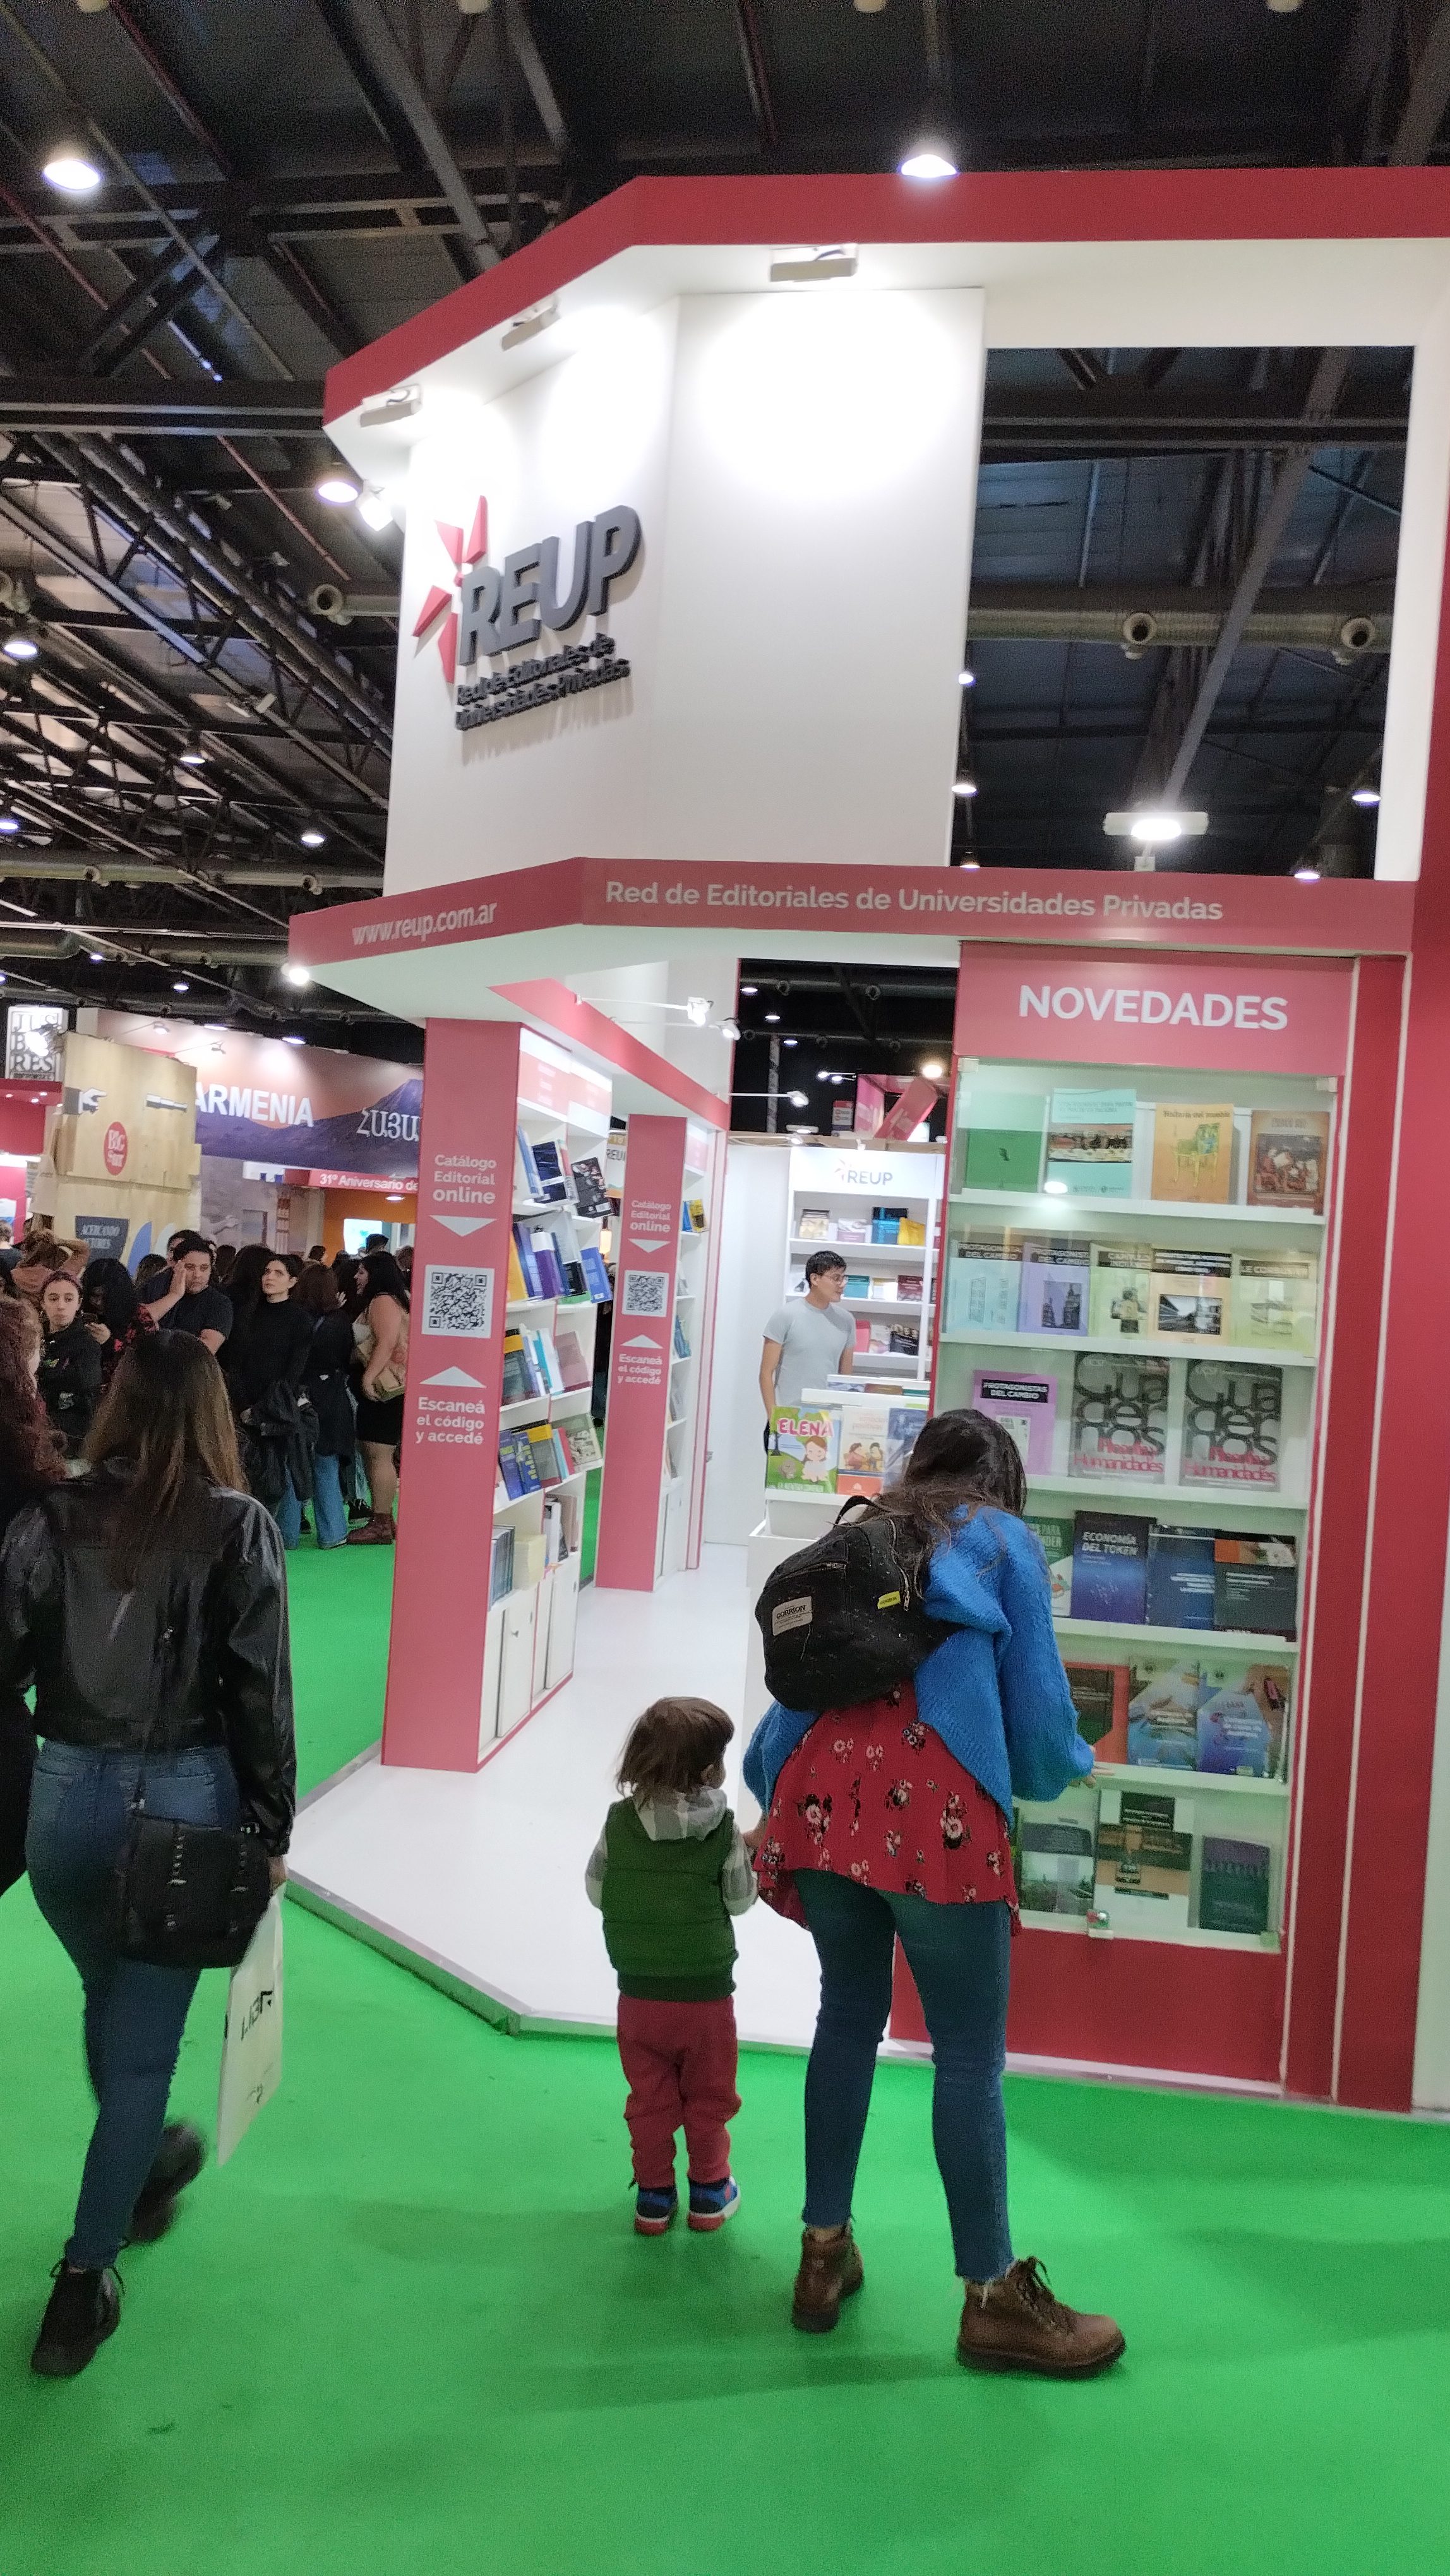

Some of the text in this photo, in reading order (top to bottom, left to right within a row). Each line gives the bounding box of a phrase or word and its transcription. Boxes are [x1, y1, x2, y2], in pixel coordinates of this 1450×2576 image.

[459, 505, 642, 665] REUP
[606, 881, 1223, 921] Red de Editoriales de Universidades Privadas
[351, 902, 498, 946] www.reup.com.ar
[1018, 984, 1288, 1031] NOVEDADES
[196, 1082, 315, 1128] ARMENIA
[434, 1154, 497, 1172] Catálogo
[340, 1175, 404, 1190] Aniversario
[434, 1170, 495, 1186] Editorial
[847, 1170, 893, 1185] REUP
[433, 1186, 496, 1204] online
[632, 1200, 671, 1211] Catálogo
[632, 1210, 671, 1220] Editorial
[630, 1220, 671, 1232] online
[619, 1354, 662, 1365] Escaneá
[618, 1365, 661, 1376] el código
[625, 1375, 661, 1385] accedé
[418, 1397, 485, 1414] Escaneá
[417, 1414, 484, 1431] el código
[777, 1418, 834, 1437] ELENA
[416, 1431, 483, 1445] y accedé
[1074, 1453, 1164, 1474] Humanidades
[1183, 1459, 1276, 1482] Humanidades
[1082, 1531, 1137, 1545] ECONOMÍA
[1082, 1542, 1138, 1556] DEL TOKEN
